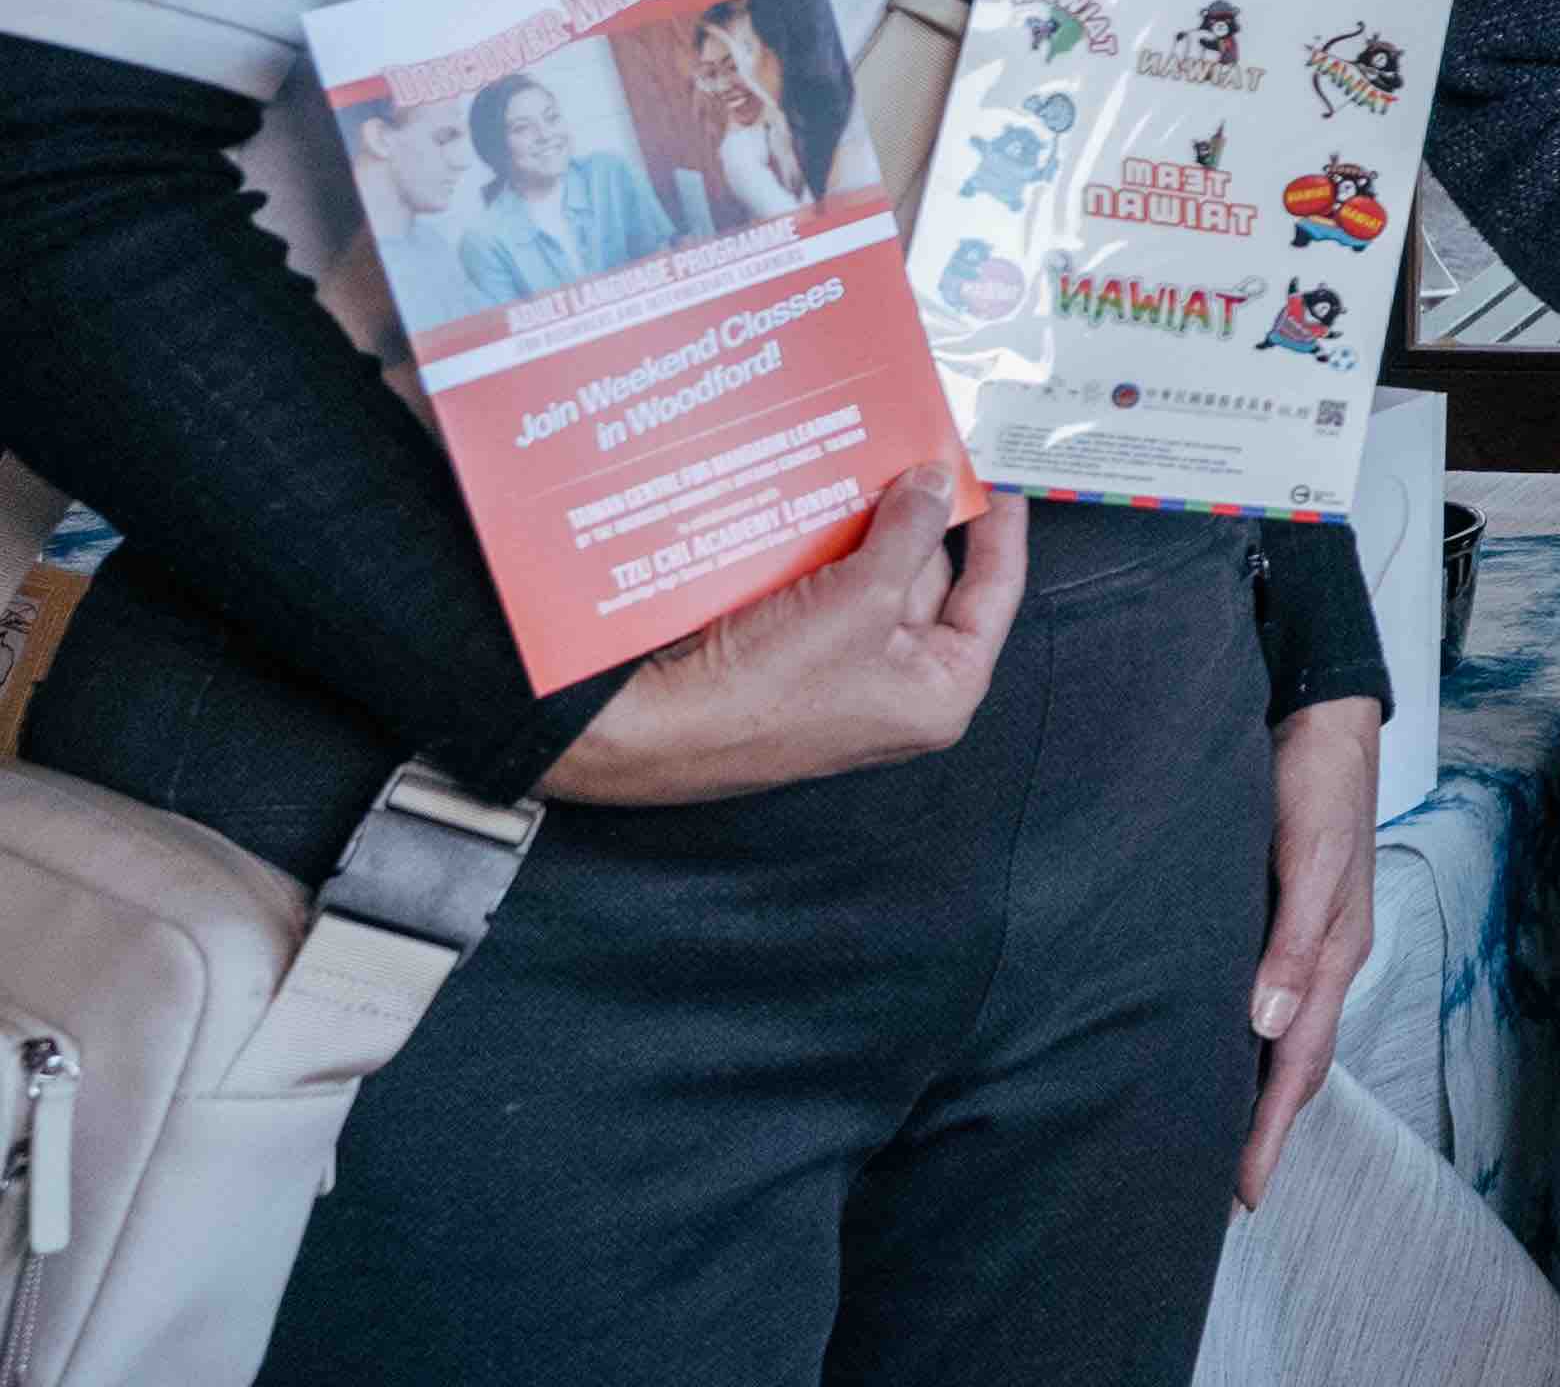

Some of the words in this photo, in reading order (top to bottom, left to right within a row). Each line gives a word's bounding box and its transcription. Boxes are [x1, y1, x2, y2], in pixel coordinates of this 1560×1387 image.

[515, 399, 580, 449] Join
[576, 327, 721, 416] Weekend
[719, 276, 846, 348] Classes
[596, 416, 629, 452] in
[625, 338, 784, 436] Woodford!
